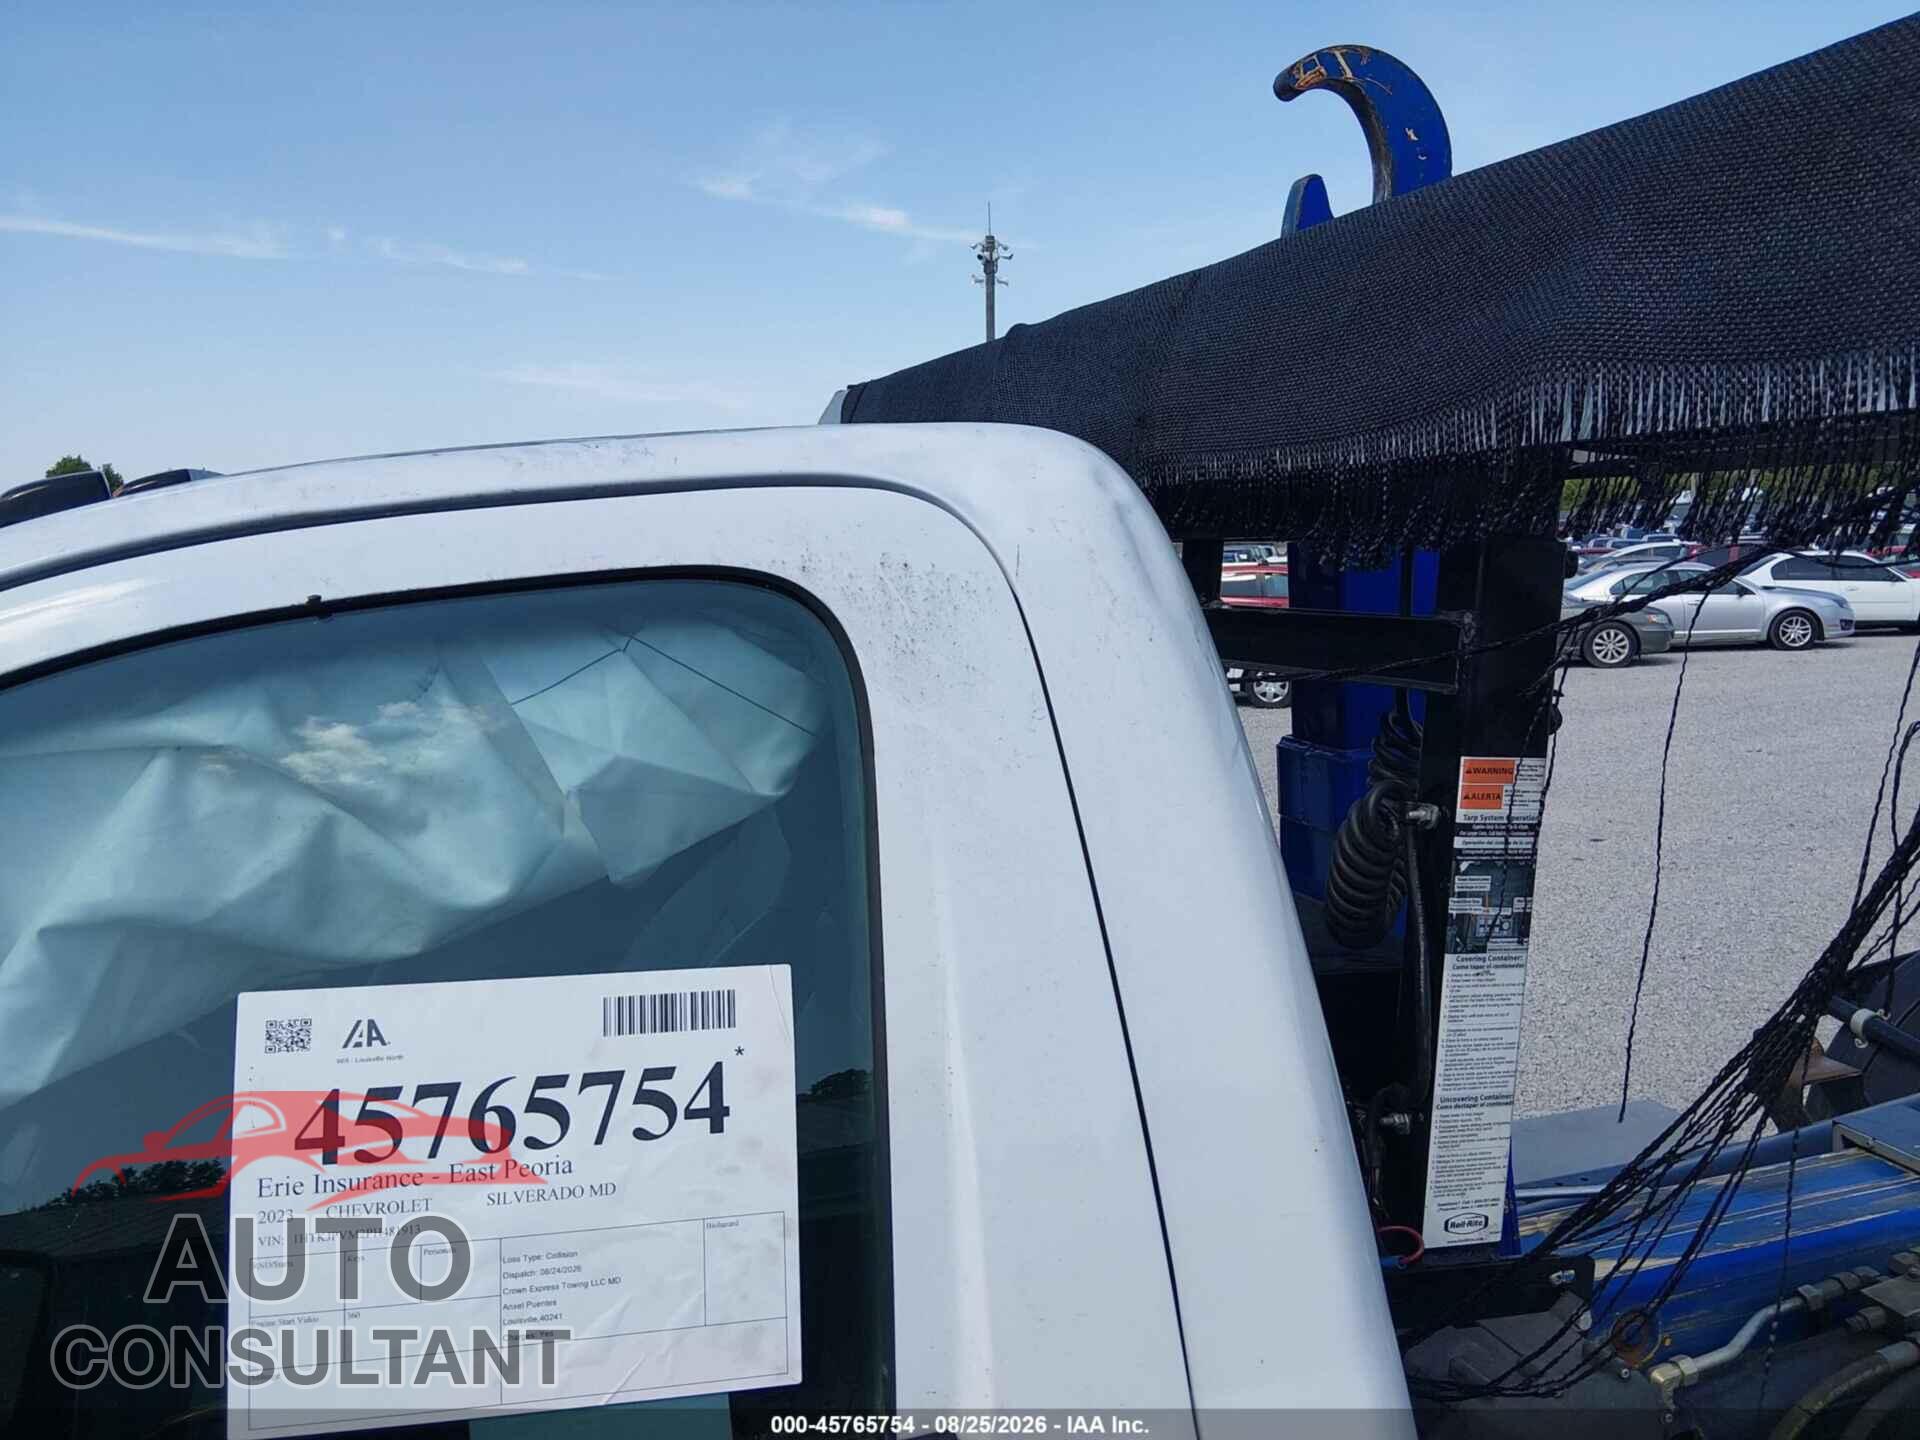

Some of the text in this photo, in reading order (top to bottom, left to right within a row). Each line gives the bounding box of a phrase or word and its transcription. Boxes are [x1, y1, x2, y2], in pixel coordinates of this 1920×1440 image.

[1472, 767, 1514, 775] WARNING
[1472, 792, 1501, 801] ALERTA
[1463, 814, 1479, 822] Tarp
[1480, 814, 1505, 822] System
[1456, 955, 1487, 963] Covering
[1440, 1095, 1479, 1103] Uncovering
[294, 1061, 731, 1167] 45765754
[257, 1175, 305, 1198] Erie
[313, 1170, 424, 1195] Insurance
[449, 1162, 496, 1184] East
[504, 1153, 573, 1179] Peoria
[257, 1182, 617, 1224] 2023 CHEVROLET SILVERADO MD
[257, 1234, 284, 1248] VIN:
[503, 1250, 579, 1264] Loss Type: Collision
[503, 1269, 539, 1280] Dispatch:
[503, 1287, 528, 1296] Crown
[529, 1283, 560, 1294] Express
[561, 1280, 590, 1290] Towing
[590, 1277, 607, 1287] LLC
